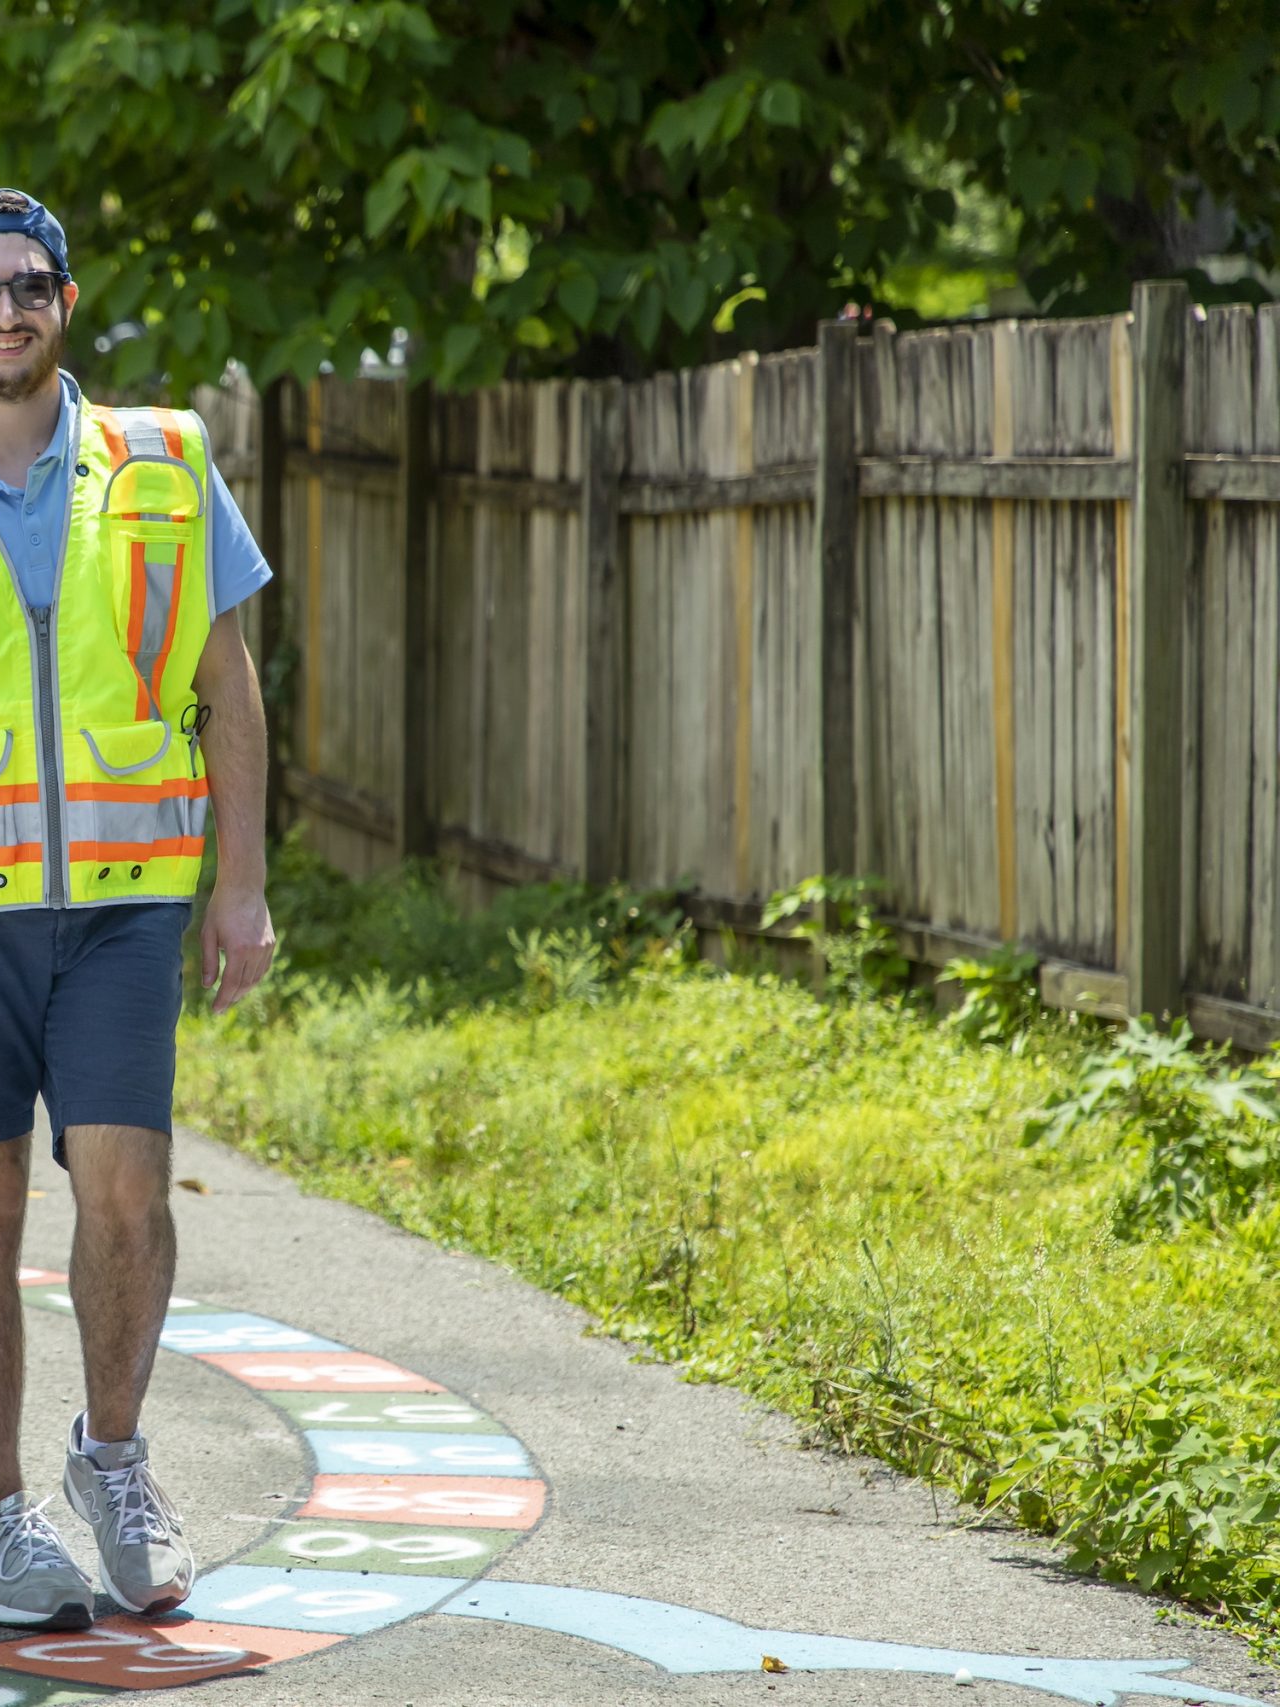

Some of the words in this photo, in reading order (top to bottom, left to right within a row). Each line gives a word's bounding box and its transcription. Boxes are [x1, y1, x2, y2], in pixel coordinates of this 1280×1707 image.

[300, 1402, 476, 1423] 57
[317, 1486, 529, 1516] 59
[282, 1530, 489, 1563] 60
[220, 1583, 402, 1617] 61
[16, 1629, 247, 1672] 62
